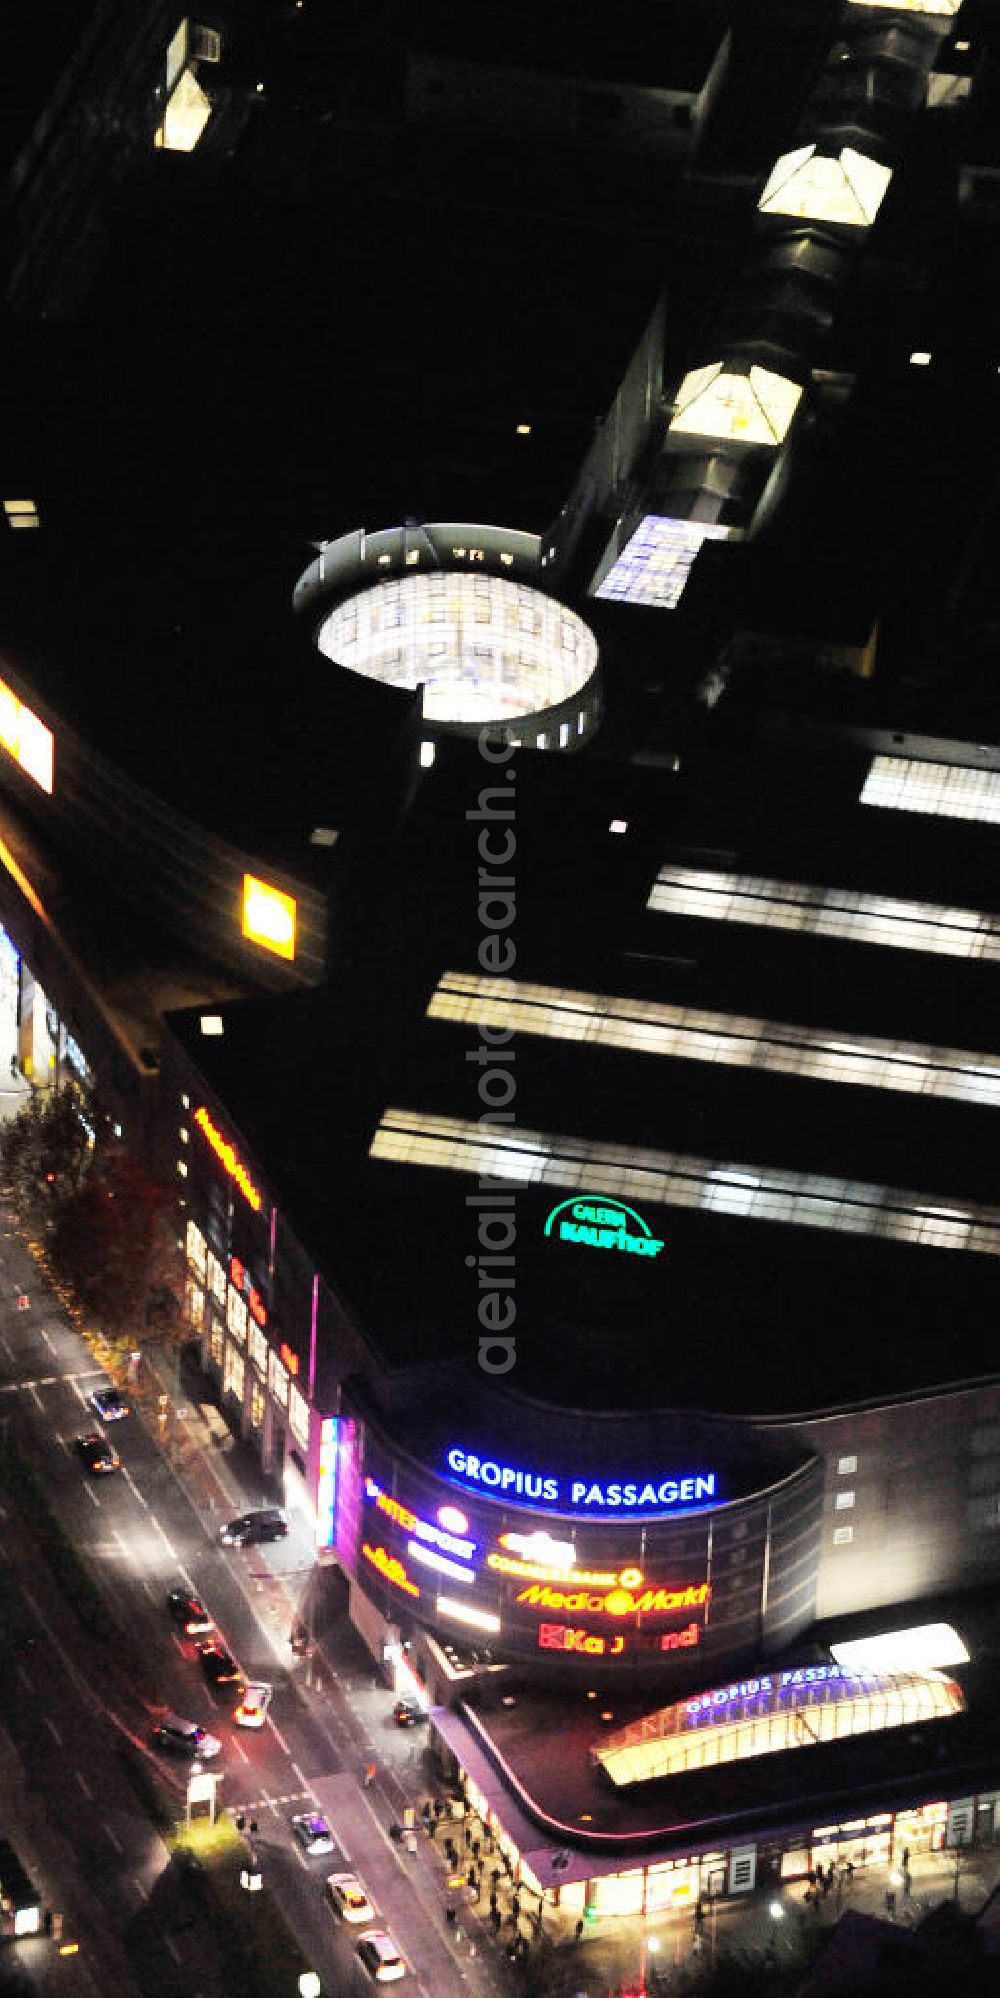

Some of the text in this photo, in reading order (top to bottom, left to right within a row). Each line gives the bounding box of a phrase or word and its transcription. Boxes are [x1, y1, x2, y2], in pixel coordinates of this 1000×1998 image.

[448, 1448, 715, 1506] GROPIUS PASSAGEN
[686, 1677, 772, 1714] GROPIUS
